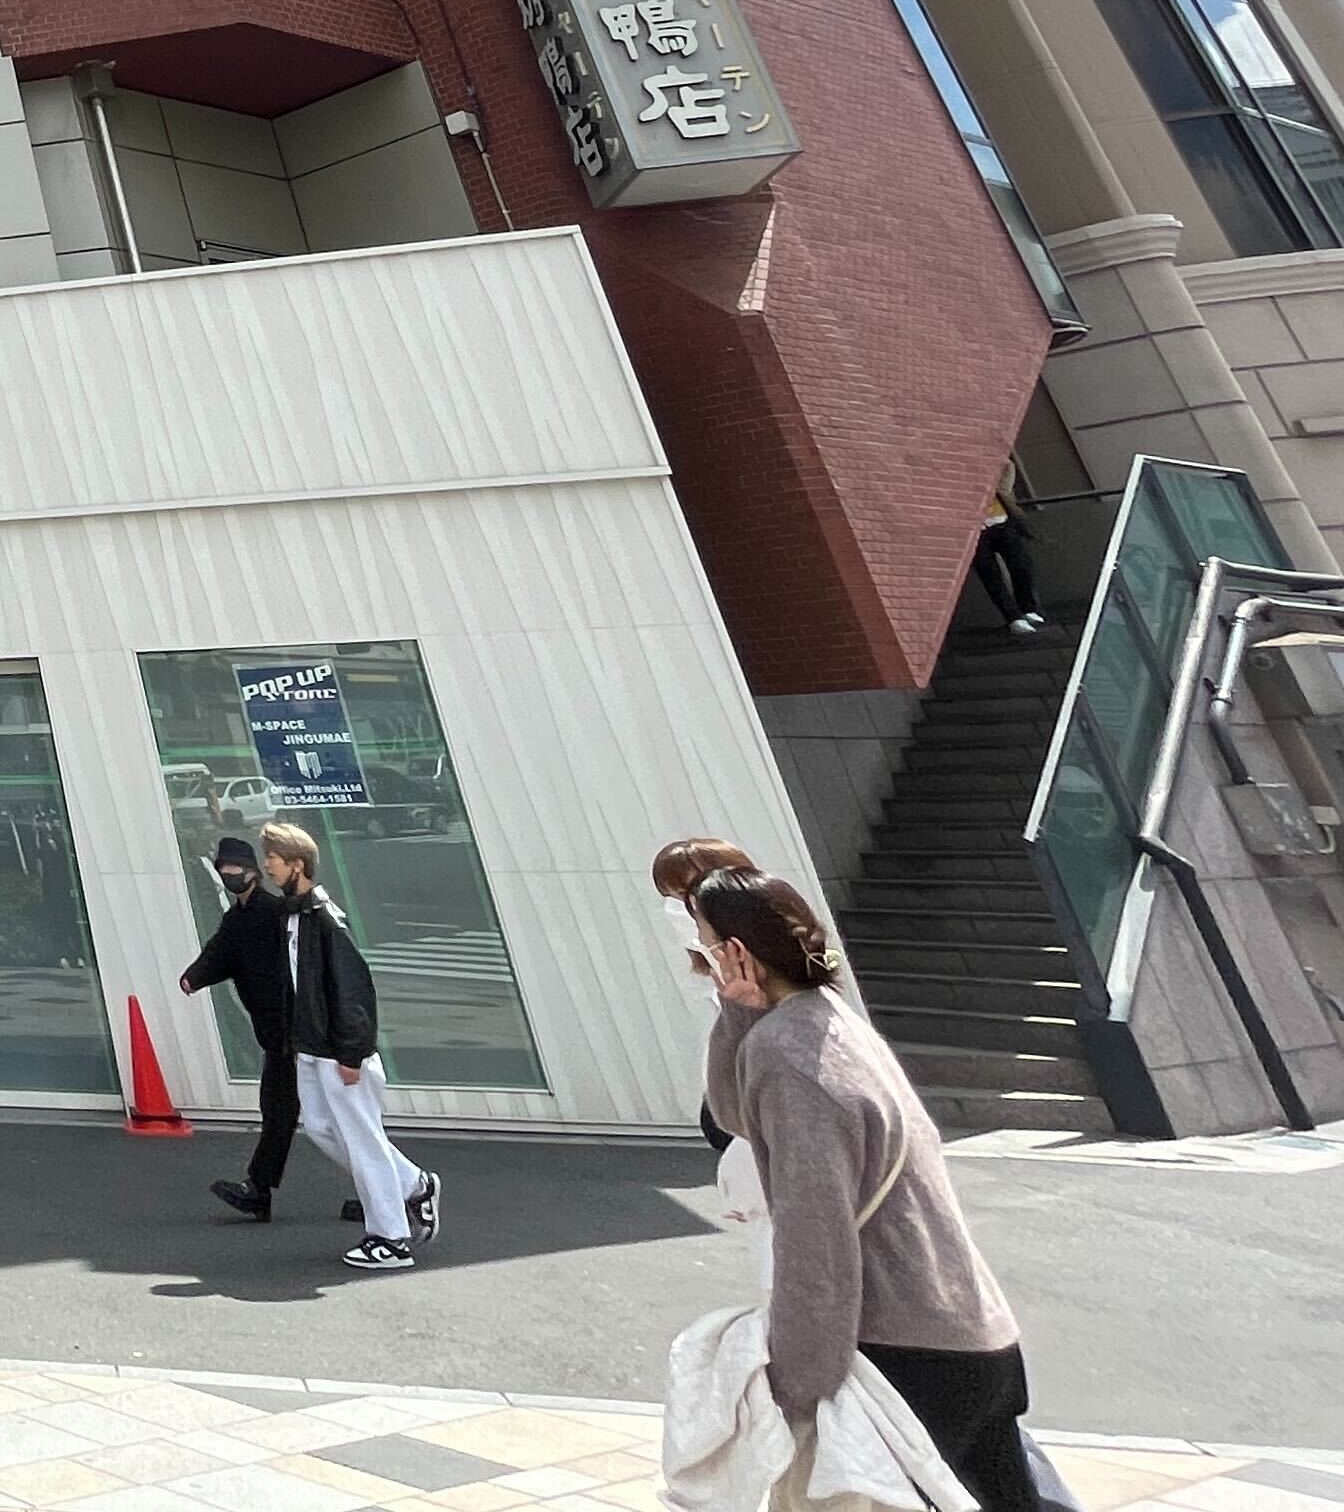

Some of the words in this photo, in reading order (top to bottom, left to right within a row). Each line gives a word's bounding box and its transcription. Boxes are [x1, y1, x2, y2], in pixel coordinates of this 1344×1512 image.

[241, 675, 294, 701] POP
[296, 665, 332, 686] UP
[251, 719, 306, 732] M-SPACE
[283, 732, 352, 746] JINGUMAE
